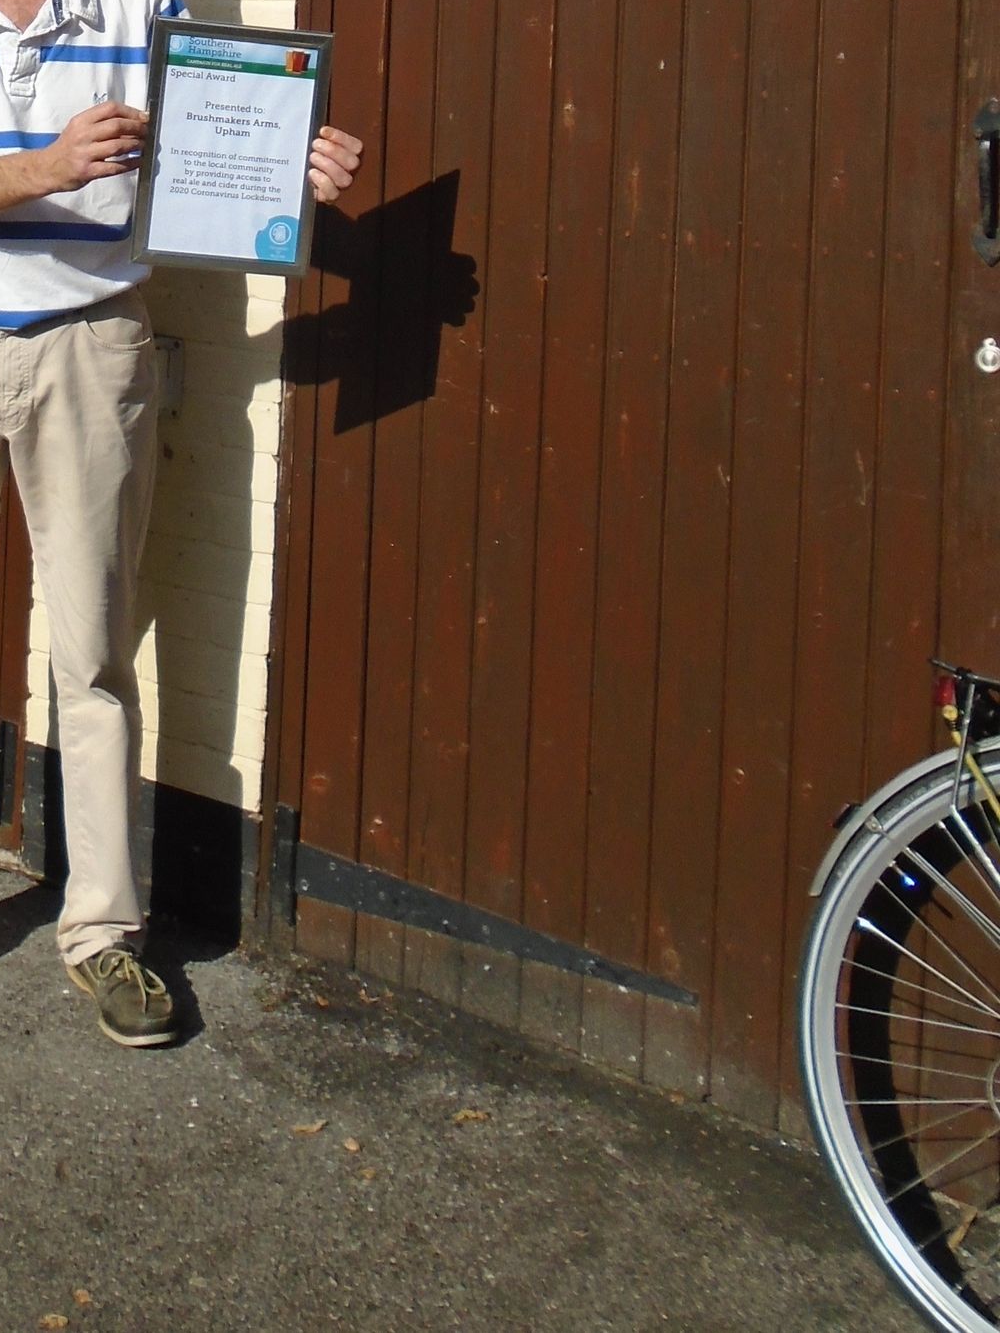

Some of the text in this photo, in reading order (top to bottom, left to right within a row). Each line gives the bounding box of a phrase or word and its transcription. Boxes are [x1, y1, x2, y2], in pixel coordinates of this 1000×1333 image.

[189, 37, 234, 48] Southern
[188, 45, 242, 58] Hampshire
[170, 68, 236, 83] Special Award
[205, 101, 252, 114] Presented
[186, 112, 281, 130] Brushmakers Arms,
[215, 126, 251, 138] Upham
[170, 147, 290, 166] In recognition of commitment
[193, 159, 207, 168] the
[208, 160, 227, 169] local
[228, 162, 274, 174] community
[184, 168, 271, 183] by providing access to
[172, 176, 281, 194] real ale and cider during the
[169, 186, 282, 204] 2020 Coronavirus Lockdown
